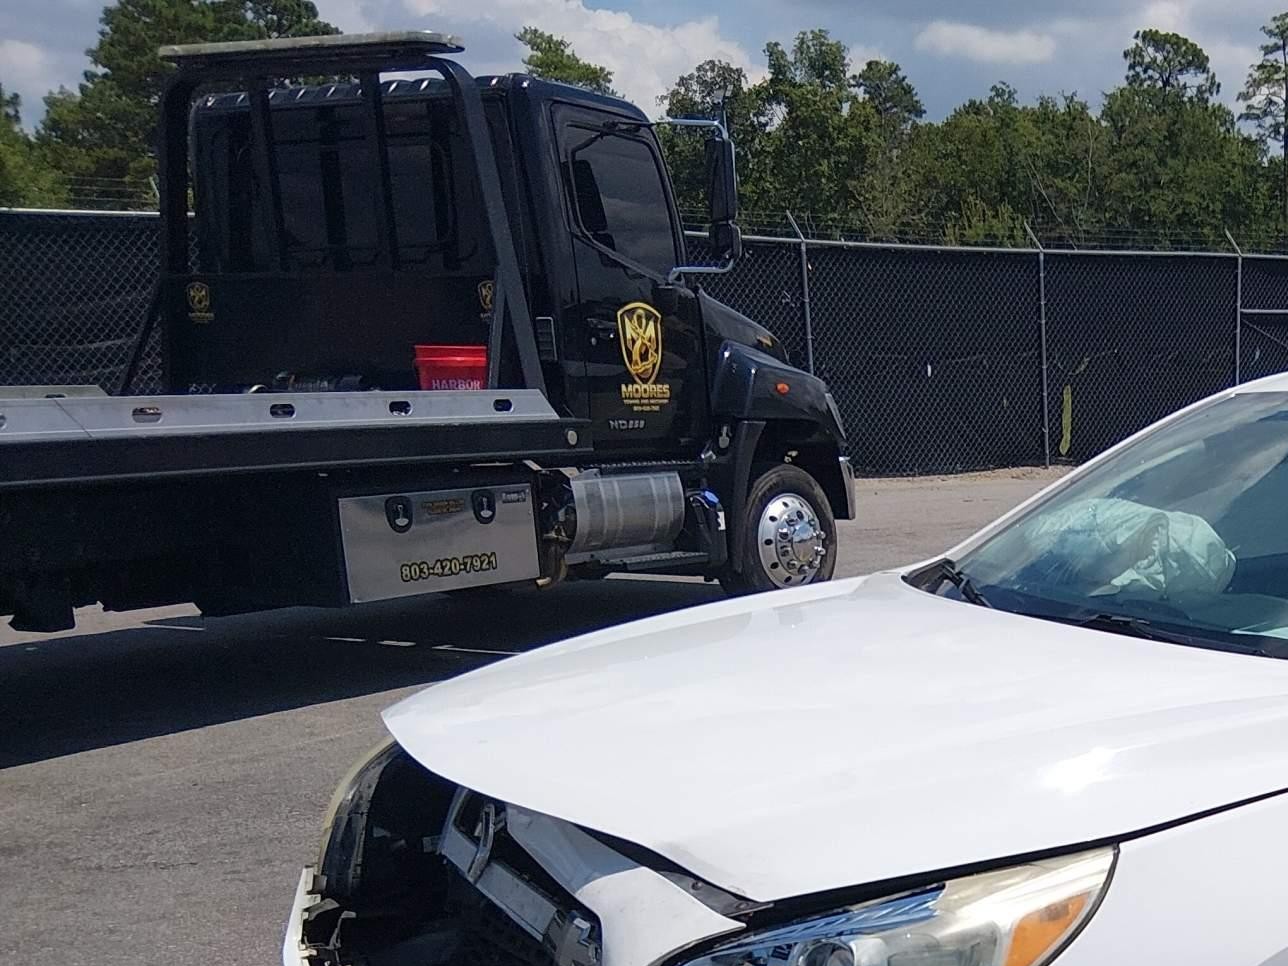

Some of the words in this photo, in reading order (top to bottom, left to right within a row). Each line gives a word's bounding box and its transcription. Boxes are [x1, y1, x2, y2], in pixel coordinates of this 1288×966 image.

[432, 379, 480, 390] HARBOR
[621, 384, 671, 398] MOORES
[401, 552, 498, 582] 803-420-7921
